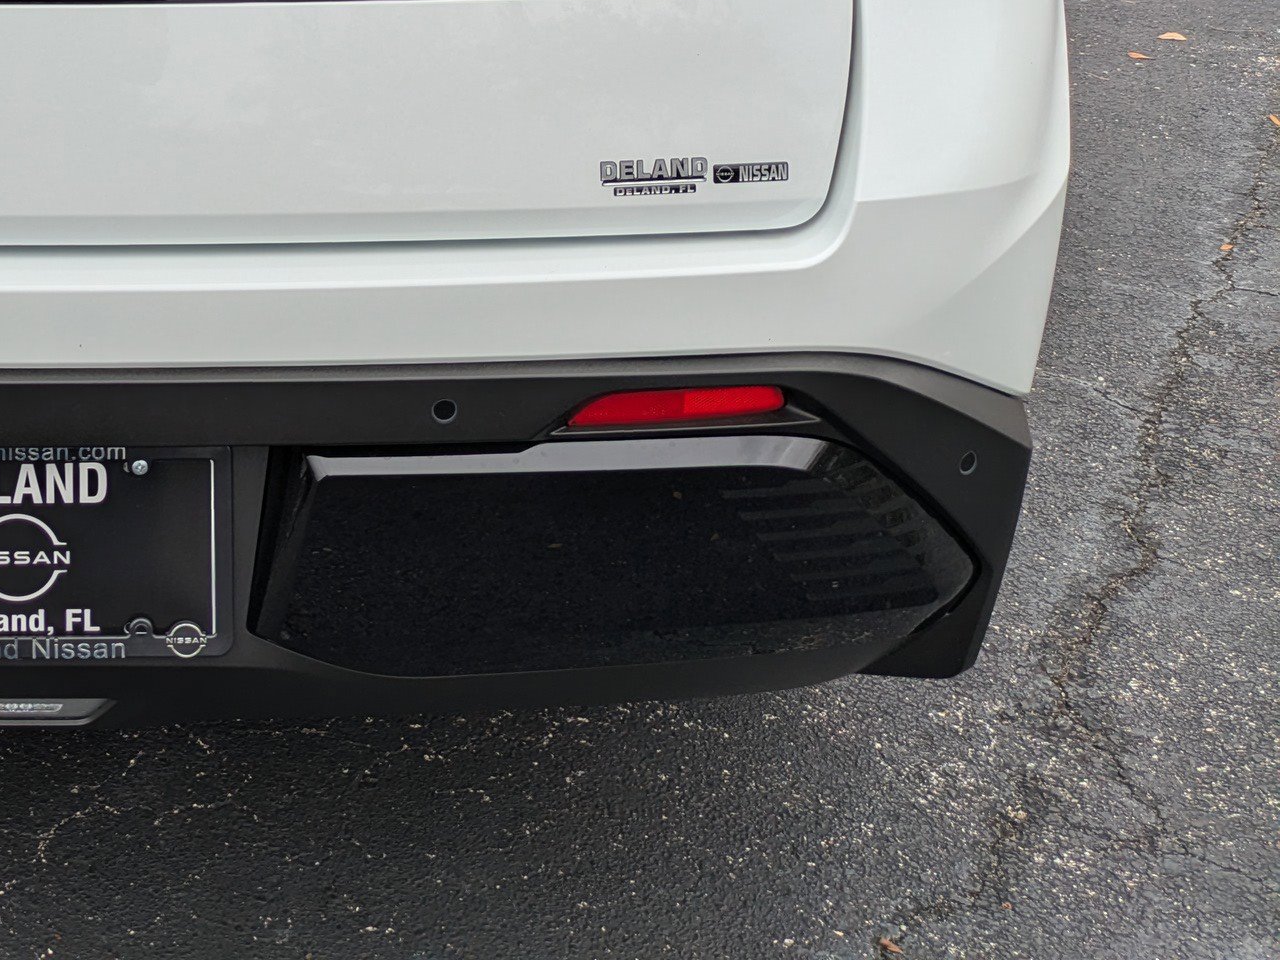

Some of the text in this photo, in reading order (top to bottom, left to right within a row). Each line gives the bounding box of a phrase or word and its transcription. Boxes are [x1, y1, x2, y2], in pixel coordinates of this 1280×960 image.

[600, 157, 708, 181] DELAND
[739, 164, 788, 182] NISSAN
[680, 184, 695, 193] FL
[65, 608, 101, 633] FL
[32, 637, 126, 660] Nissan
